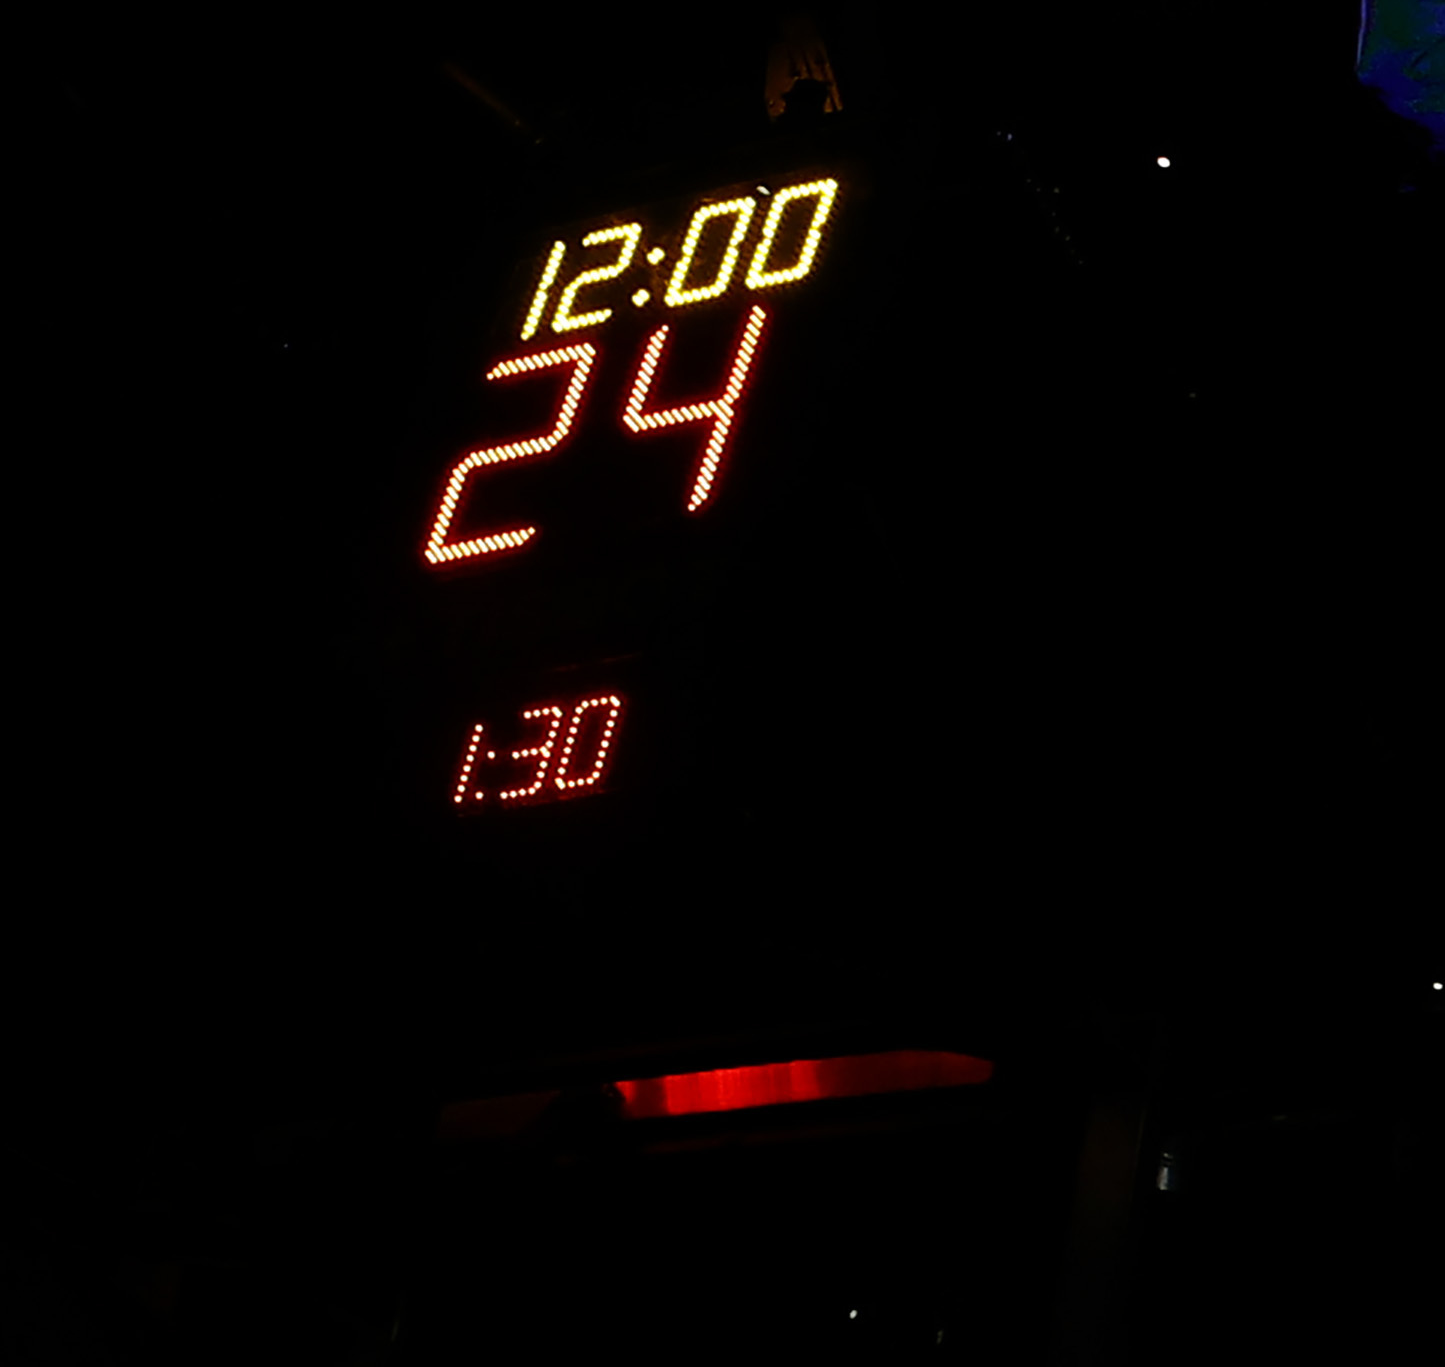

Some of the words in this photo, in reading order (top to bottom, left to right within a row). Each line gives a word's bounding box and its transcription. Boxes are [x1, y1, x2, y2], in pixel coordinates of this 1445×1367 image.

[520, 176, 841, 342] 12:00
[422, 304, 770, 567] 24
[452, 691, 624, 806] 1:30
